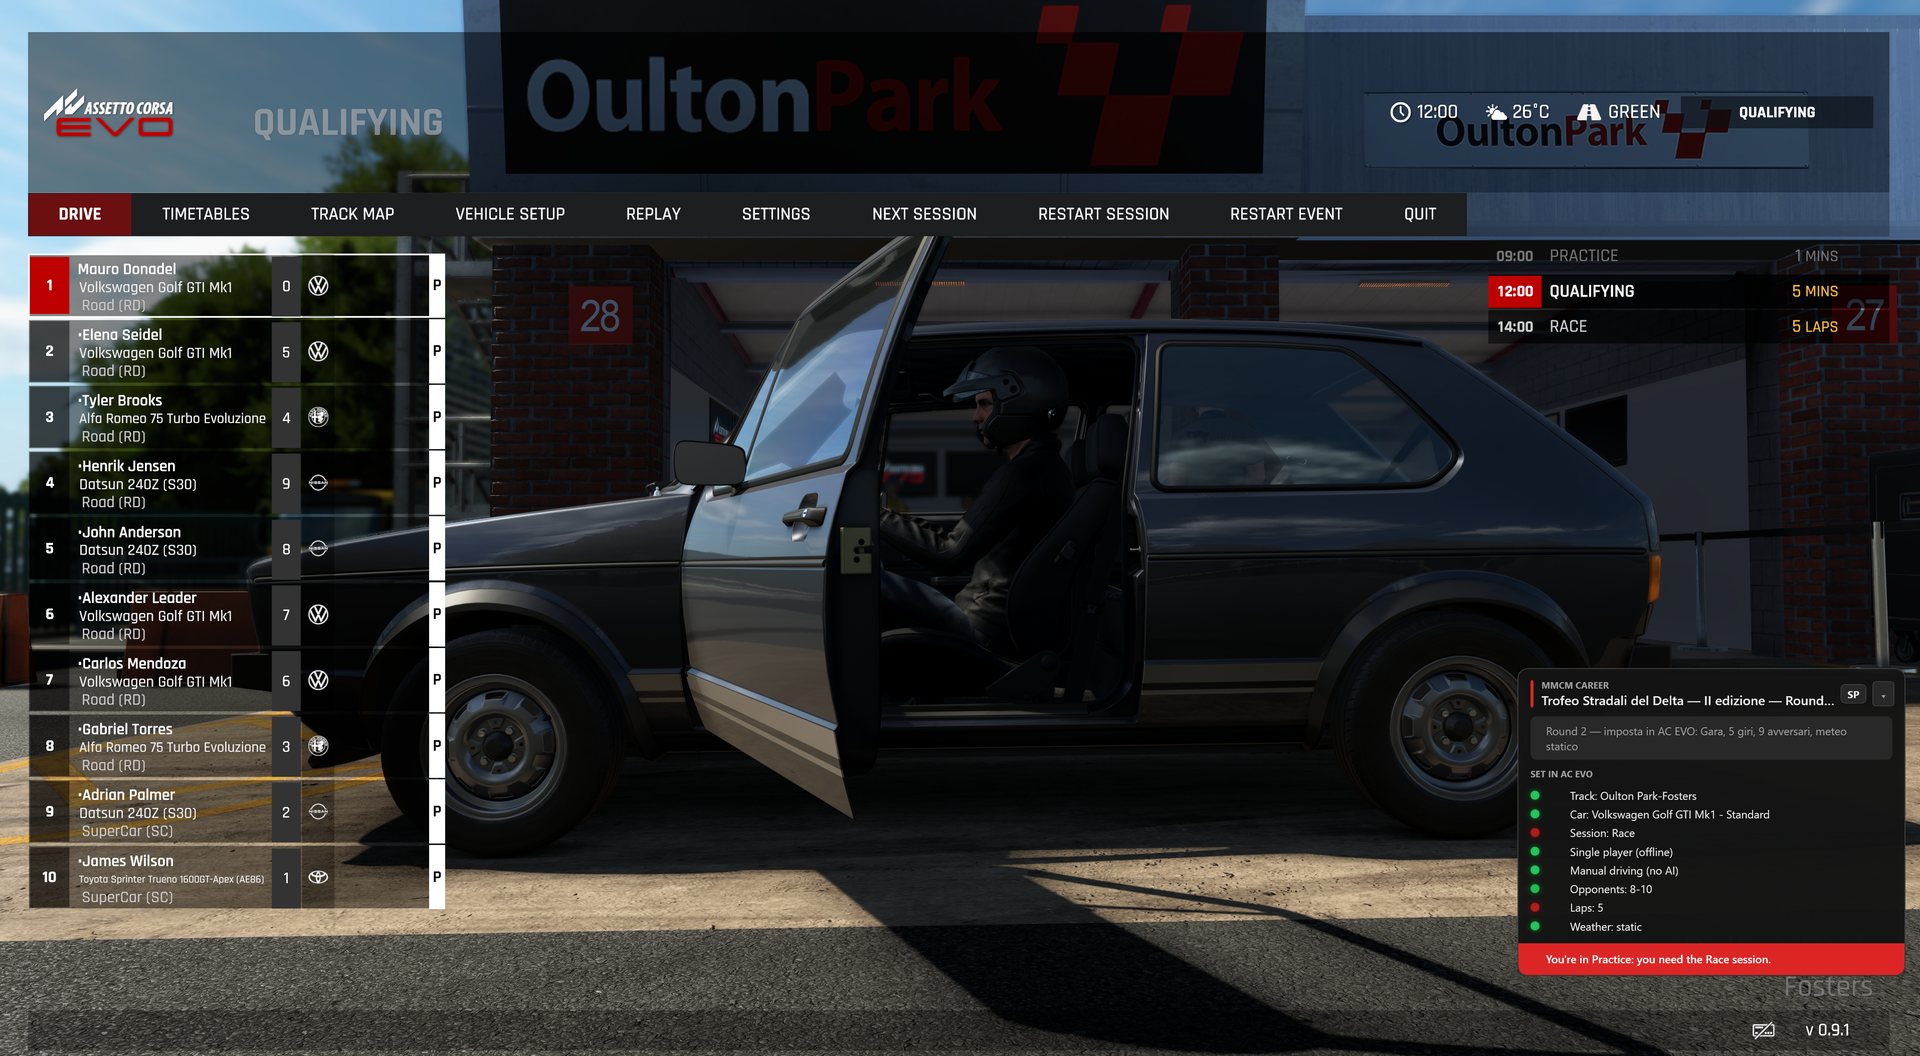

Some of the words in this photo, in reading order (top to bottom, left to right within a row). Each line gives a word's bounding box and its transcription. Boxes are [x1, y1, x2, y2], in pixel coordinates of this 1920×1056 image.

[84, 102, 135, 115] ASSETTO
[136, 102, 174, 115] CORSA
[1417, 104, 1458, 119] 12:00
[1512, 102, 1550, 119] 26°C
[1608, 104, 1660, 119] GREEN
[1739, 106, 1816, 121] QUALIFYING
[56, 117, 173, 137] EVO
[254, 107, 443, 141] QUALIFYING
[58, 206, 102, 221] DRIVE
[161, 207, 250, 221] TIMETABLES
[310, 207, 358, 221] TRACK
[363, 207, 395, 221] MAP
[455, 207, 515, 221] VEHICLE
[519, 207, 565, 221] SETUP
[626, 207, 682, 221] REPLAY
[742, 207, 811, 221] SETTINGS
[872, 207, 909, 221] NEXT
[913, 207, 977, 221] SESSION
[1038, 207, 1102, 221] RESTART
[1106, 207, 1169, 221] SESSION
[1230, 207, 1294, 221] RESTART
[1298, 207, 1344, 221] EVENT
[1404, 207, 1437, 223] QUIT
[1496, 250, 1534, 262] 09:00
[1550, 248, 1619, 262] PRACTICE
[1794, 249, 1801, 263] 1
[1805, 249, 1839, 263] MINS
[78, 263, 119, 275] Mauro
[123, 262, 176, 275] Donadel
[46, 279, 53, 291] 1
[79, 280, 154, 296] Volkswagen
[158, 280, 183, 293] Golf
[186, 281, 205, 293] GTI
[209, 280, 232, 293] Mk1
[282, 280, 291, 292] 0
[433, 279, 442, 291] P
[1497, 285, 1534, 297] 12:00
[1792, 284, 1801, 298] 5
[1805, 285, 1839, 297] MINS
[1550, 284, 1635, 300] QUALIFYING
[82, 299, 114, 311] Road
[119, 299, 145, 313] (RD)
[580, 299, 620, 332] 28
[1845, 299, 1885, 331] 27
[1497, 320, 1534, 333] 14:00
[1550, 319, 1587, 333] RACE
[1792, 319, 1801, 333] 5
[1805, 320, 1838, 333] LAPS
[122, 328, 162, 341] Seidel
[118, 393, 163, 406] Brooks
[45, 410, 54, 423] 3
[79, 412, 102, 424] Alfa
[106, 413, 147, 424] Romeo
[150, 413, 164, 424] 75
[167, 412, 200, 424] Turbo
[204, 412, 266, 424] Evoluzione
[128, 460, 176, 472] Jensen
[79, 478, 124, 490] Datsun
[127, 478, 159, 490] 240Z
[163, 478, 197, 492] (S30)
[119, 525, 181, 538] Anderson
[45, 542, 54, 554] 5
[152, 591, 197, 604] Leader
[127, 656, 186, 669] Mendoza
[1541, 681, 1573, 690] MMCM
[1575, 681, 1610, 690] CAREER
[1541, 695, 1580, 706] Trofeo
[1582, 694, 1628, 706] Stradali
[1630, 695, 1649, 706] del
[1652, 695, 1684, 706] Delta
[1704, 695, 1712, 706] II
[1715, 694, 1766, 706] edizione
[1785, 695, 1835, 706] Round...
[1847, 690, 1860, 699] SP
[131, 723, 173, 735] Torres
[1546, 726, 1578, 736] Round
[1580, 726, 1587, 736] 2
[1603, 726, 1643, 739] imposta
[1646, 726, 1655, 736] in
[1657, 726, 1672, 736] AC
[1674, 726, 1698, 736] EVO:
[1700, 726, 1726, 737] Gara,
[1728, 726, 1735, 737] 5
[1737, 726, 1756, 739] giri,
[1758, 726, 1765, 736] 9
[1767, 726, 1813, 738] avversari,
[1815, 727, 1847, 736] meteo
[1545, 741, 1579, 752] statico
[1530, 770, 1547, 778] SET
[1548, 770, 1559, 778] IN
[1560, 770, 1573, 778] AC
[1575, 770, 1593, 778] EVO
[129, 788, 176, 801] Palmer
[1569, 790, 1598, 801] Track:
[1600, 790, 1634, 801] Oulton
[1637, 790, 1697, 801] Park-Fosters
[1569, 809, 1589, 820] Car:
[1591, 809, 1650, 822] Volkswagen
[1652, 809, 1674, 820] Golf
[1675, 809, 1692, 820] GTI
[1694, 809, 1715, 820] Mk1
[1726, 809, 1770, 820] Standard
[1569, 828, 1609, 838] Session:
[1612, 828, 1636, 838] Race
[1569, 846, 1601, 860] Single
[1602, 847, 1633, 860] player
[1635, 846, 1674, 859] (offline)
[130, 854, 174, 867] Wilson
[42, 871, 57, 883] 10
[283, 872, 289, 884] 1
[433, 870, 442, 883] P
[1570, 865, 1607, 876] Manual
[1609, 865, 1643, 878] driving
[1646, 866, 1663, 878] (no
[1664, 865, 1679, 877] AI)
[78, 874, 109, 886] Toyota
[110, 874, 146, 885] Sprinter
[147, 874, 178, 884] Trueno
[179, 874, 234, 885] 1600GT-Apex
[236, 874, 265, 885] (AE86)
[1569, 884, 1627, 897] Opponents:
[1629, 884, 1653, 894] 8-10
[82, 891, 143, 905] SuperCar
[146, 891, 173, 905] (SC)
[1570, 903, 1595, 915] Laps:
[1597, 902, 1604, 913] 5
[1569, 921, 1614, 932] Weather:
[1616, 921, 1643, 932] static
[1545, 954, 1577, 964] You're
[1579, 954, 1589, 964] in
[1592, 954, 1634, 964] Practice:
[1636, 957, 1656, 967] you
[1658, 954, 1684, 965] need
[1686, 954, 1703, 964] the
[1705, 954, 1730, 964] Race
[1732, 954, 1772, 964] session.
[1784, 975, 1873, 998] Fosters
[1805, 1028, 1814, 1036] v
[1818, 1023, 1850, 1037] 0.9.1
